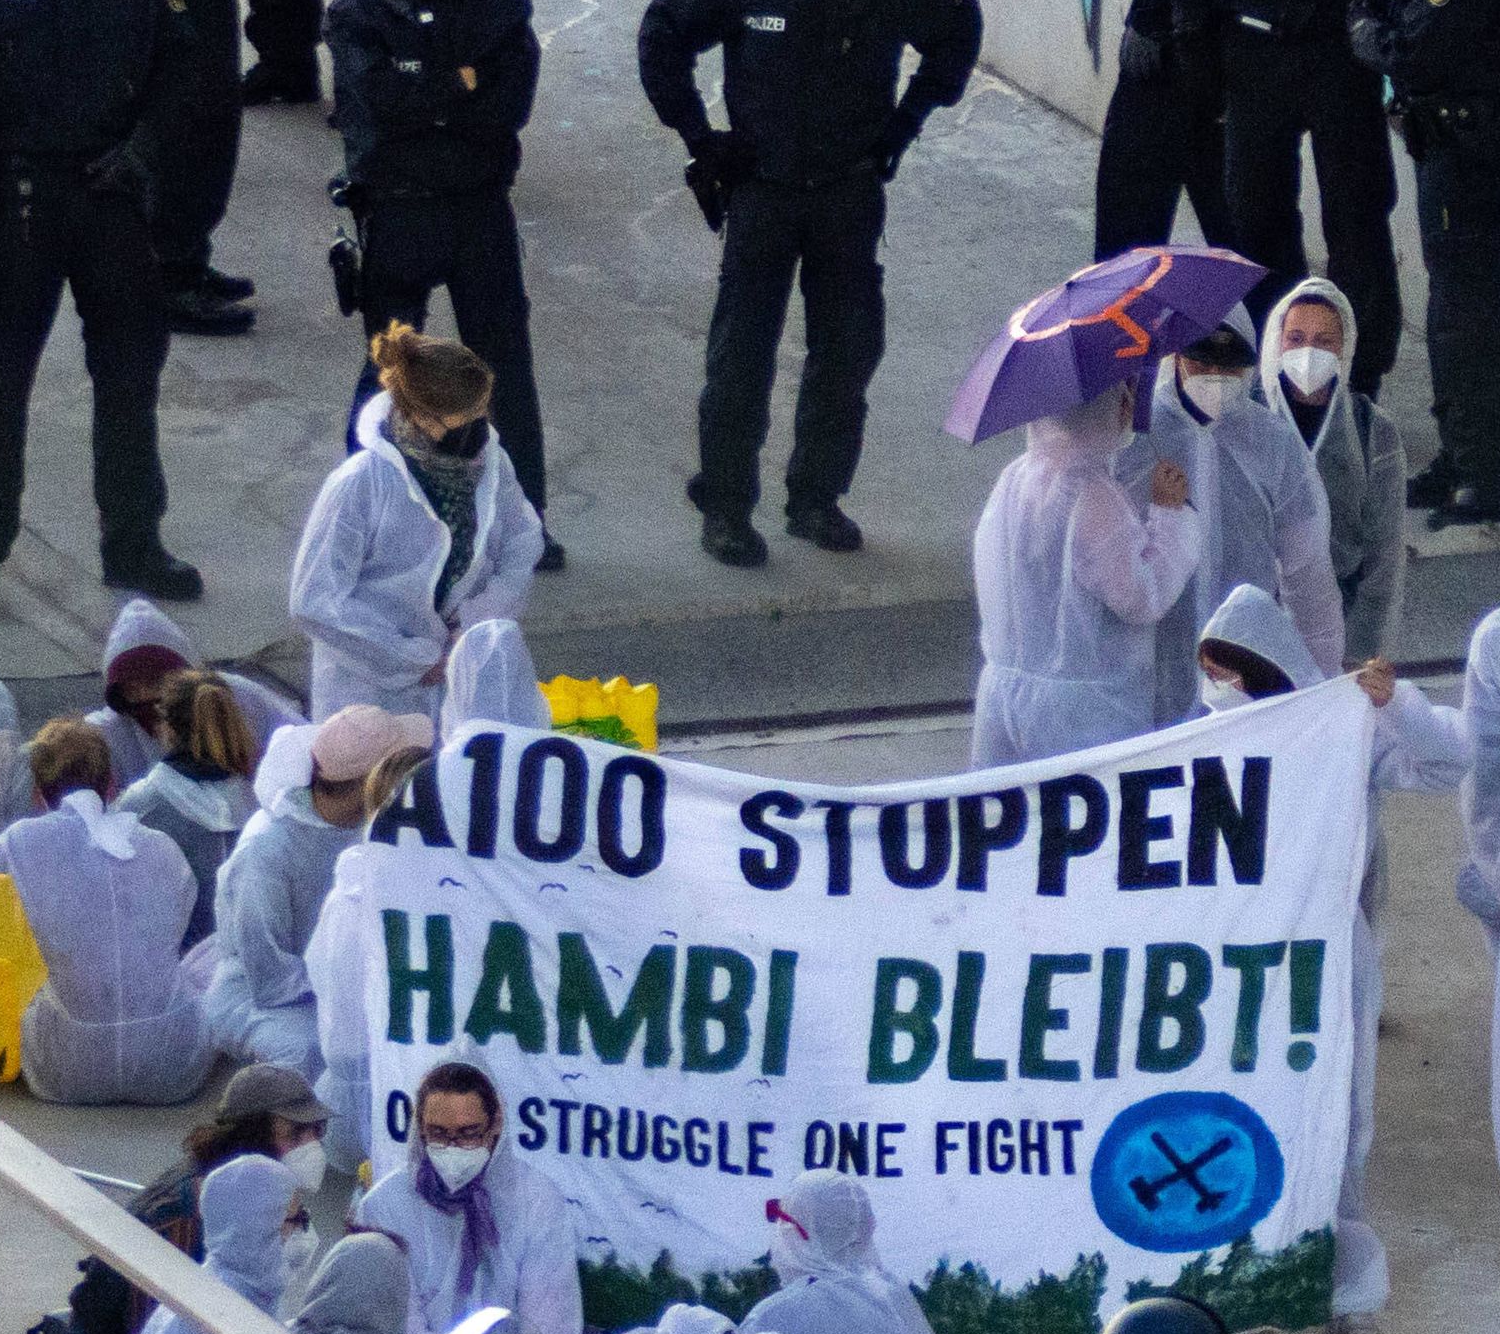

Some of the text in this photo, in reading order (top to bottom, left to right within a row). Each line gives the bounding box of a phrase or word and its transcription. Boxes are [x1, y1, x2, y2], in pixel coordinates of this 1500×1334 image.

[372, 731, 1272, 898] A100 STOPPEN
[380, 908, 1328, 1085] HAMBI BLEIBT!
[514, 1095, 1085, 1179] STRUGGLE ONE FIGHT
